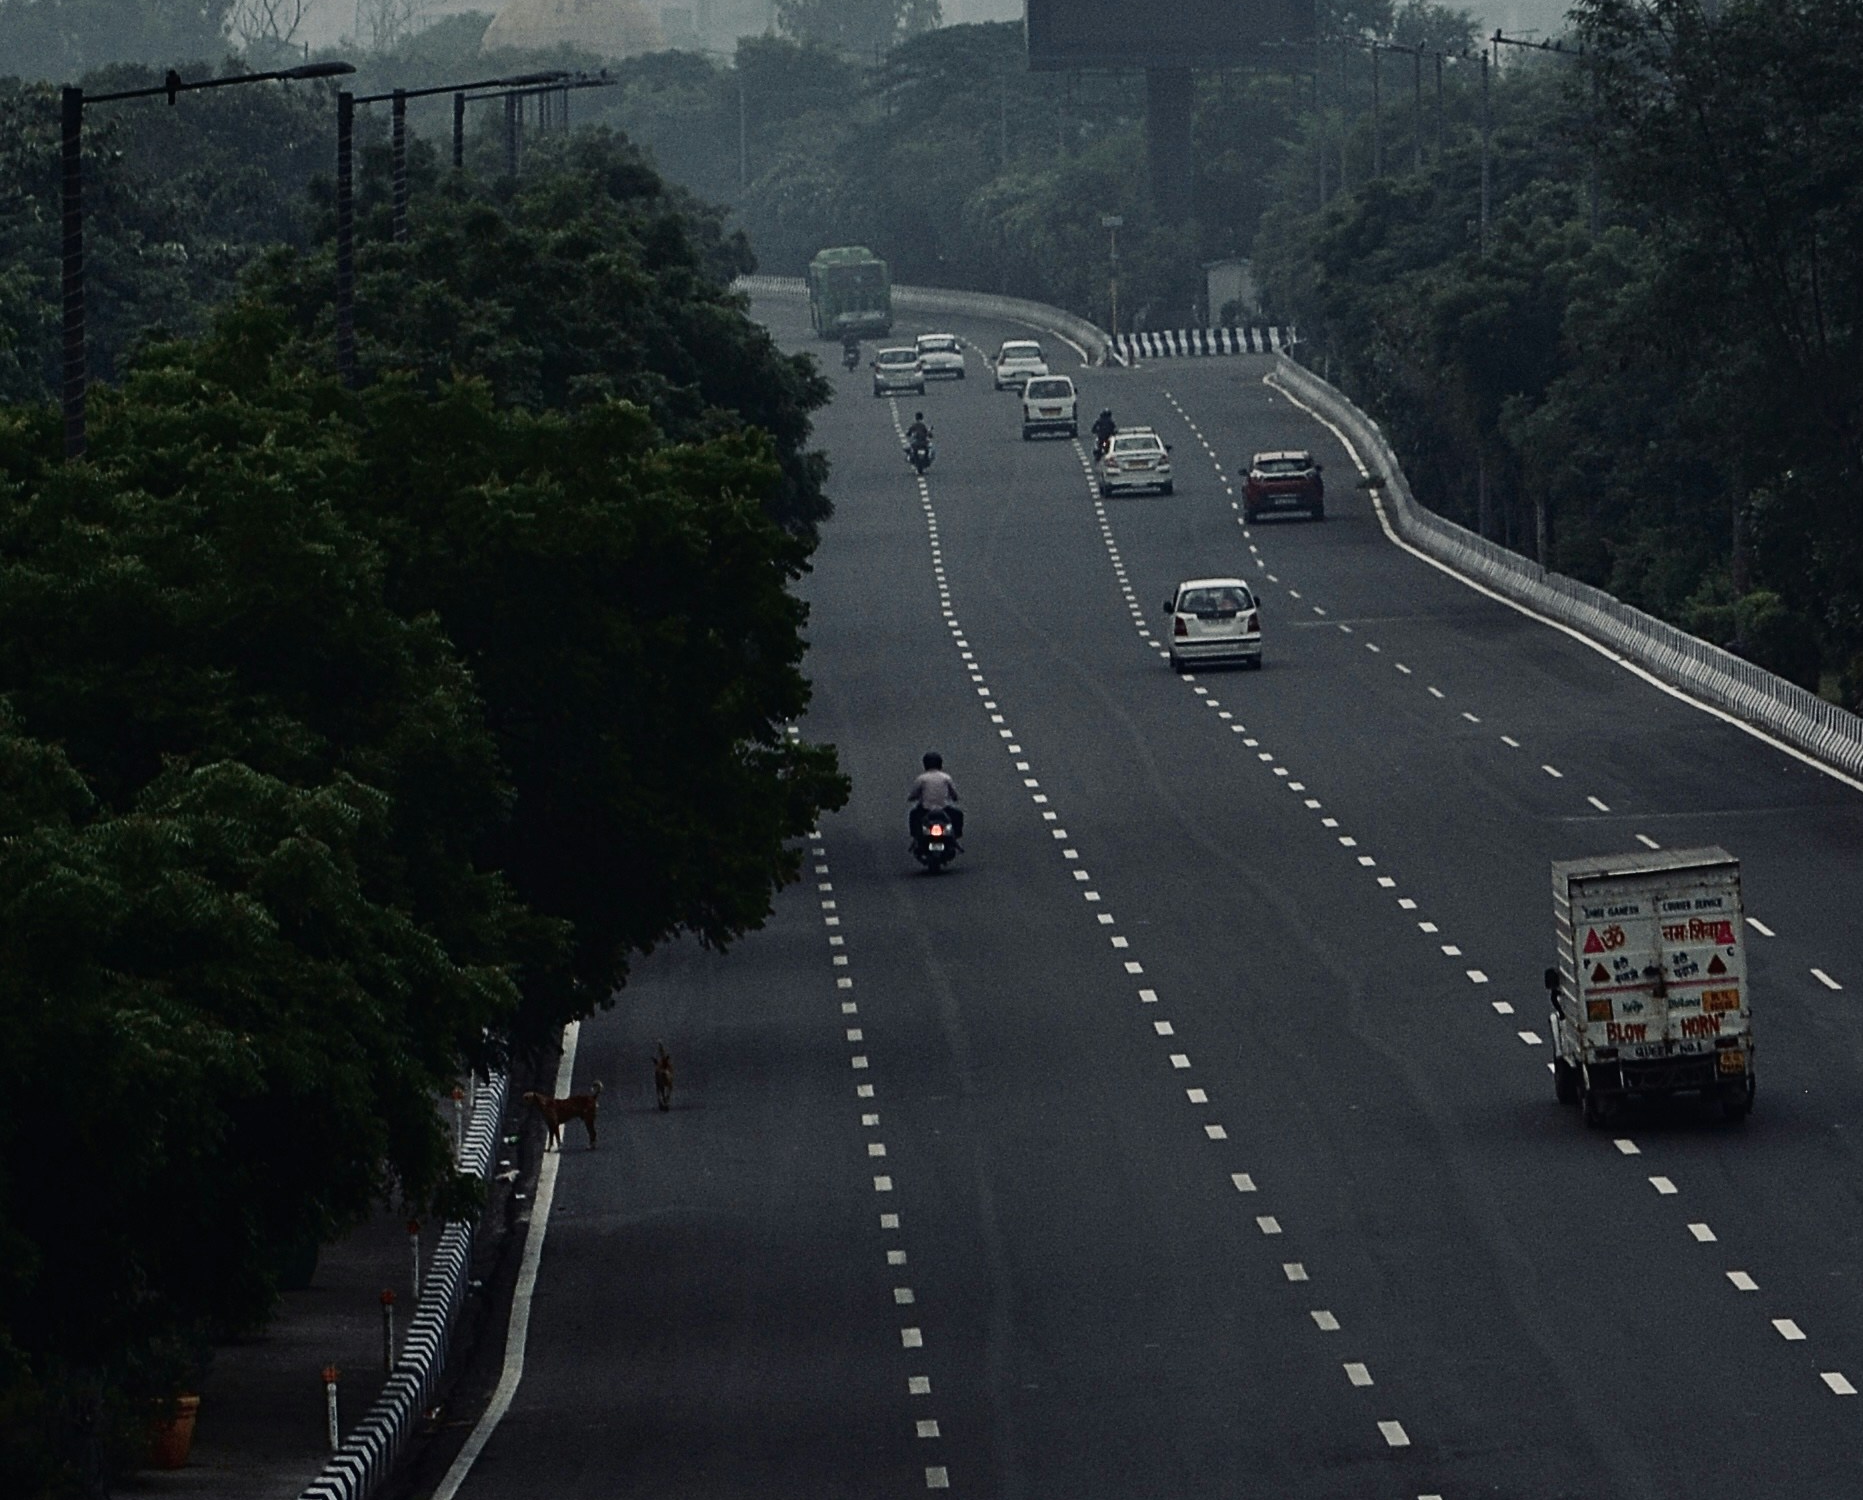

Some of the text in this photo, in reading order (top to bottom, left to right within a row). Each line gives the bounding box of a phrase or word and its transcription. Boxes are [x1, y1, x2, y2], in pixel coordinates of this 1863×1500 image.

[1606, 1013, 1720, 1042] BLOW HORN
[1635, 1044, 1673, 1058] QUEEN
